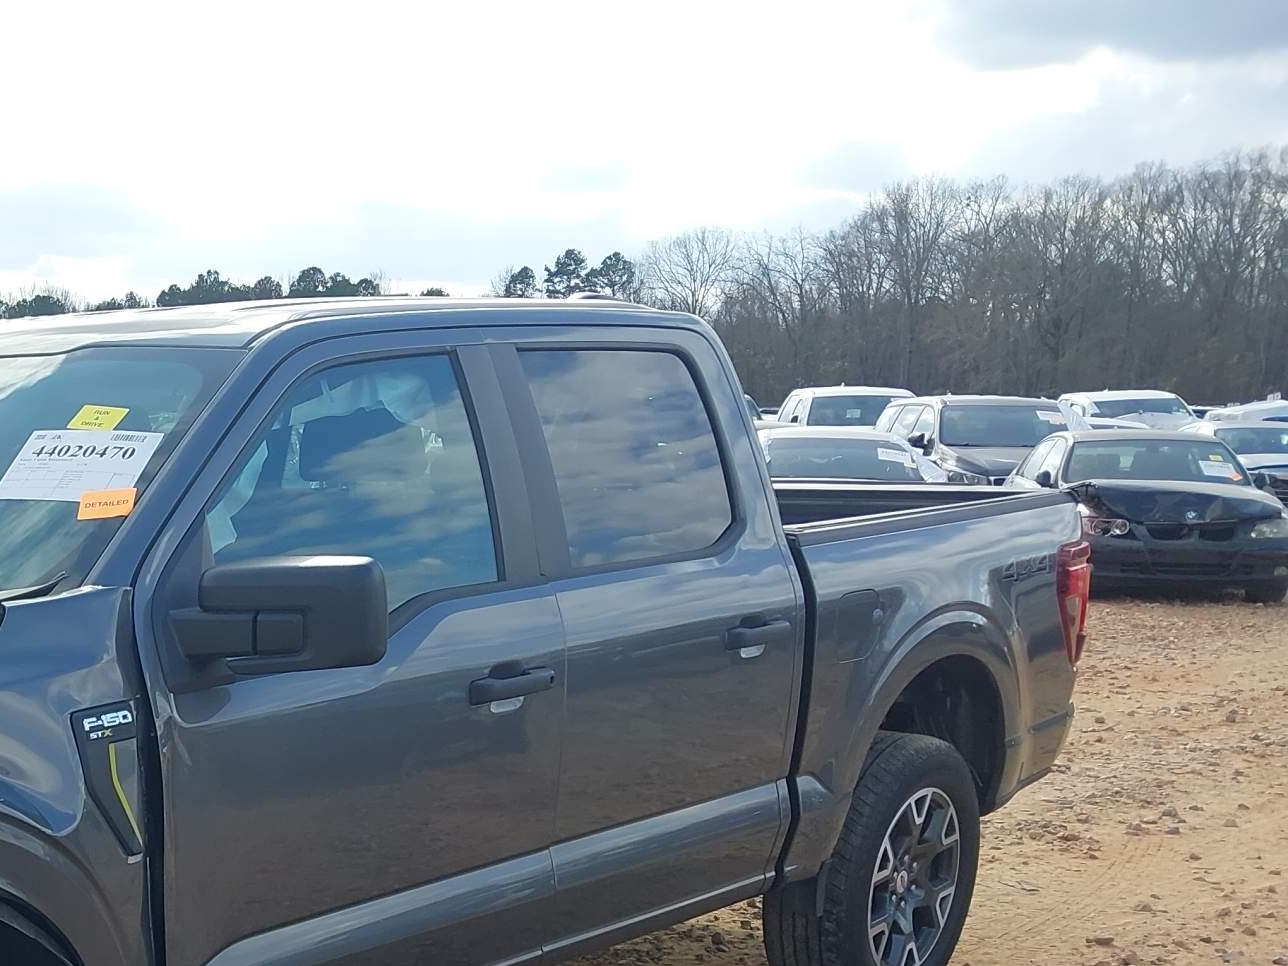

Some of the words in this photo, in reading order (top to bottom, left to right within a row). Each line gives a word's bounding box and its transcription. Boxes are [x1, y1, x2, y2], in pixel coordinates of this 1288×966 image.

[32, 445, 136, 460] 44020470
[85, 500, 129, 509] DETAILED
[83, 710, 132, 731] F-150
[90, 729, 112, 740] STX
